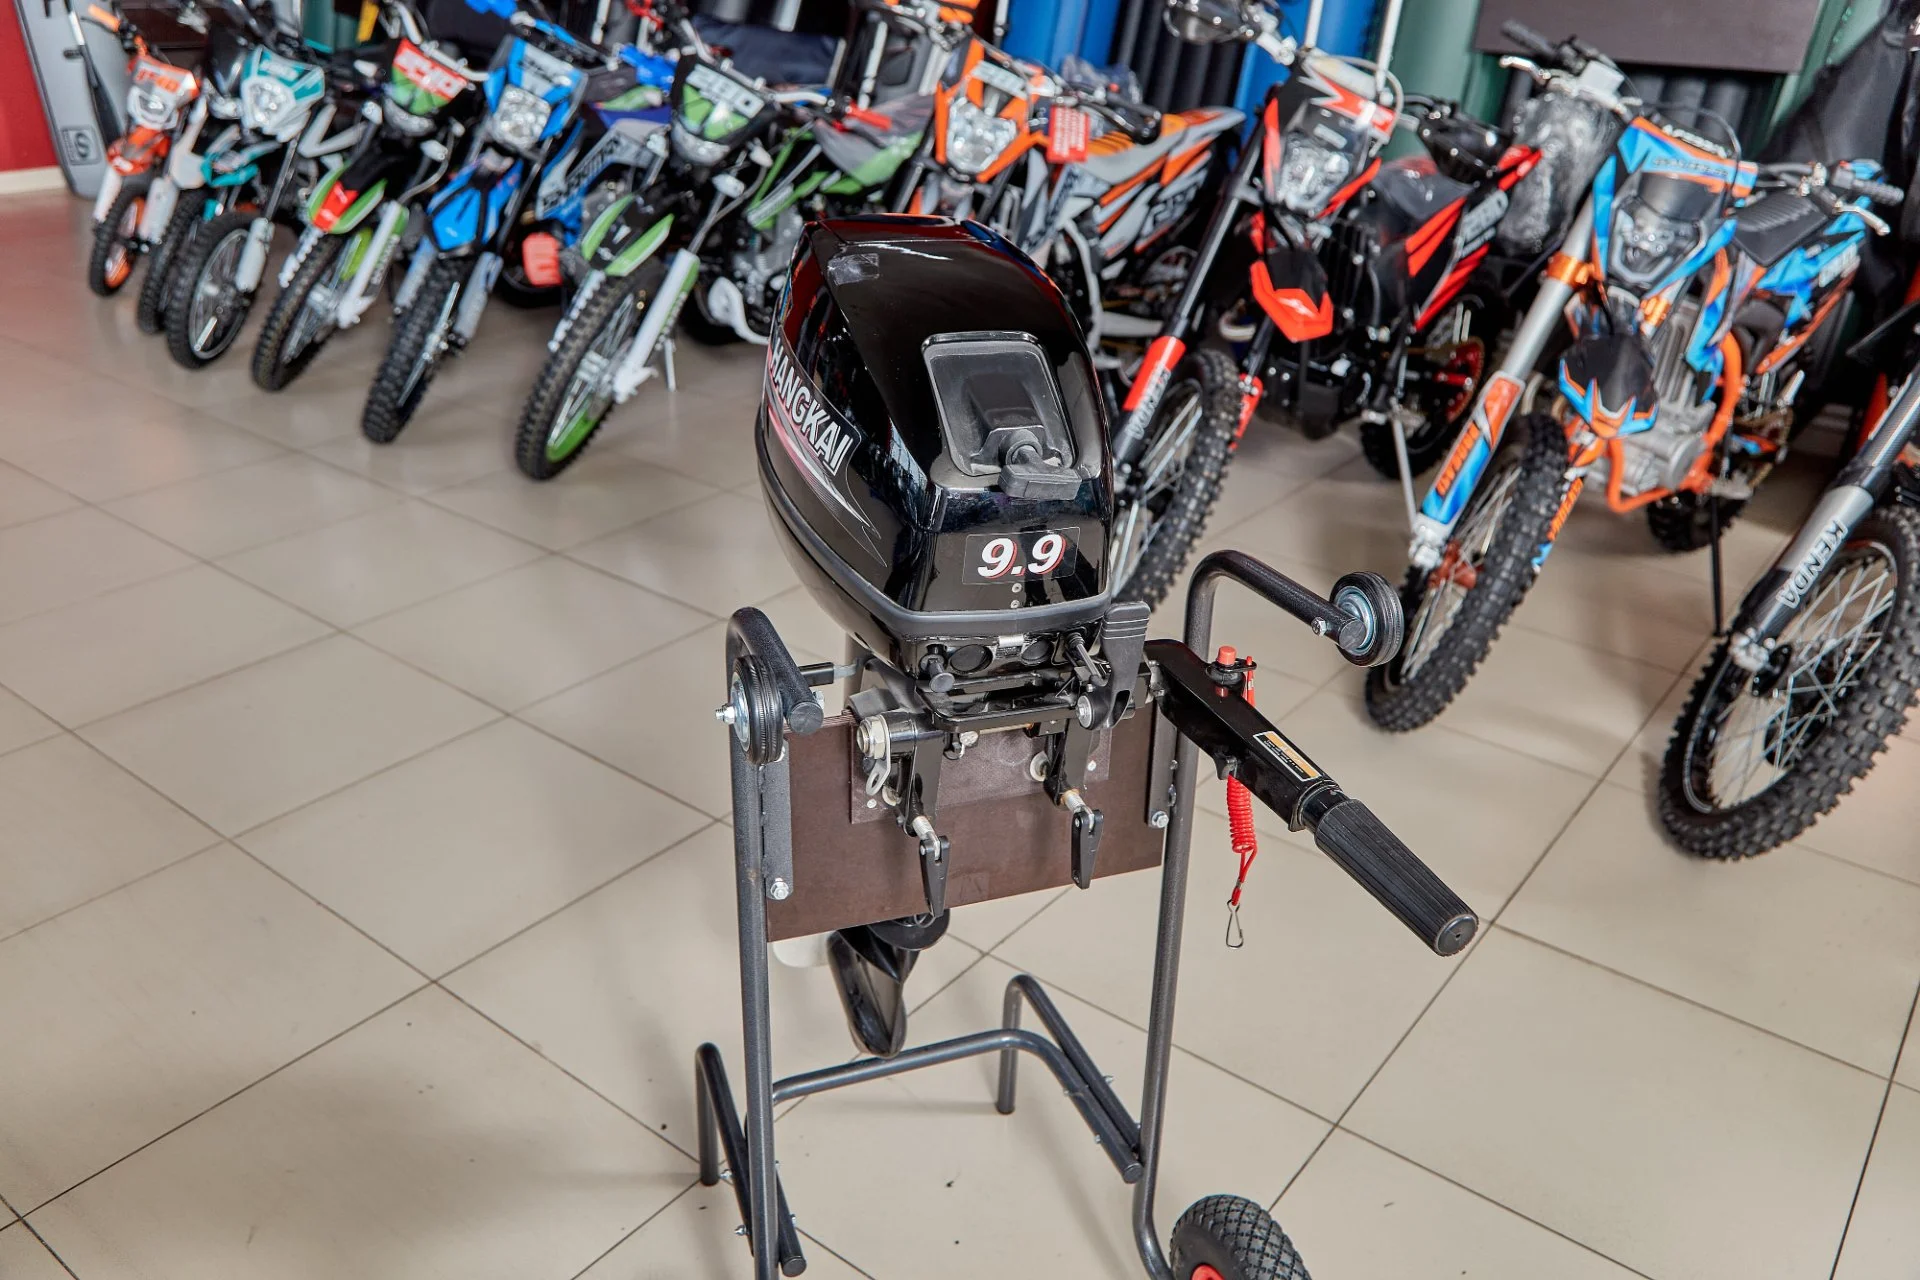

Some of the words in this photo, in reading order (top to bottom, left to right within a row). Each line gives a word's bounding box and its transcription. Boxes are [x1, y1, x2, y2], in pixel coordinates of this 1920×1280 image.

[770, 337, 853, 476] HANGKAI
[978, 534, 1067, 580] 9.9
[1776, 518, 1848, 609] KENDA
